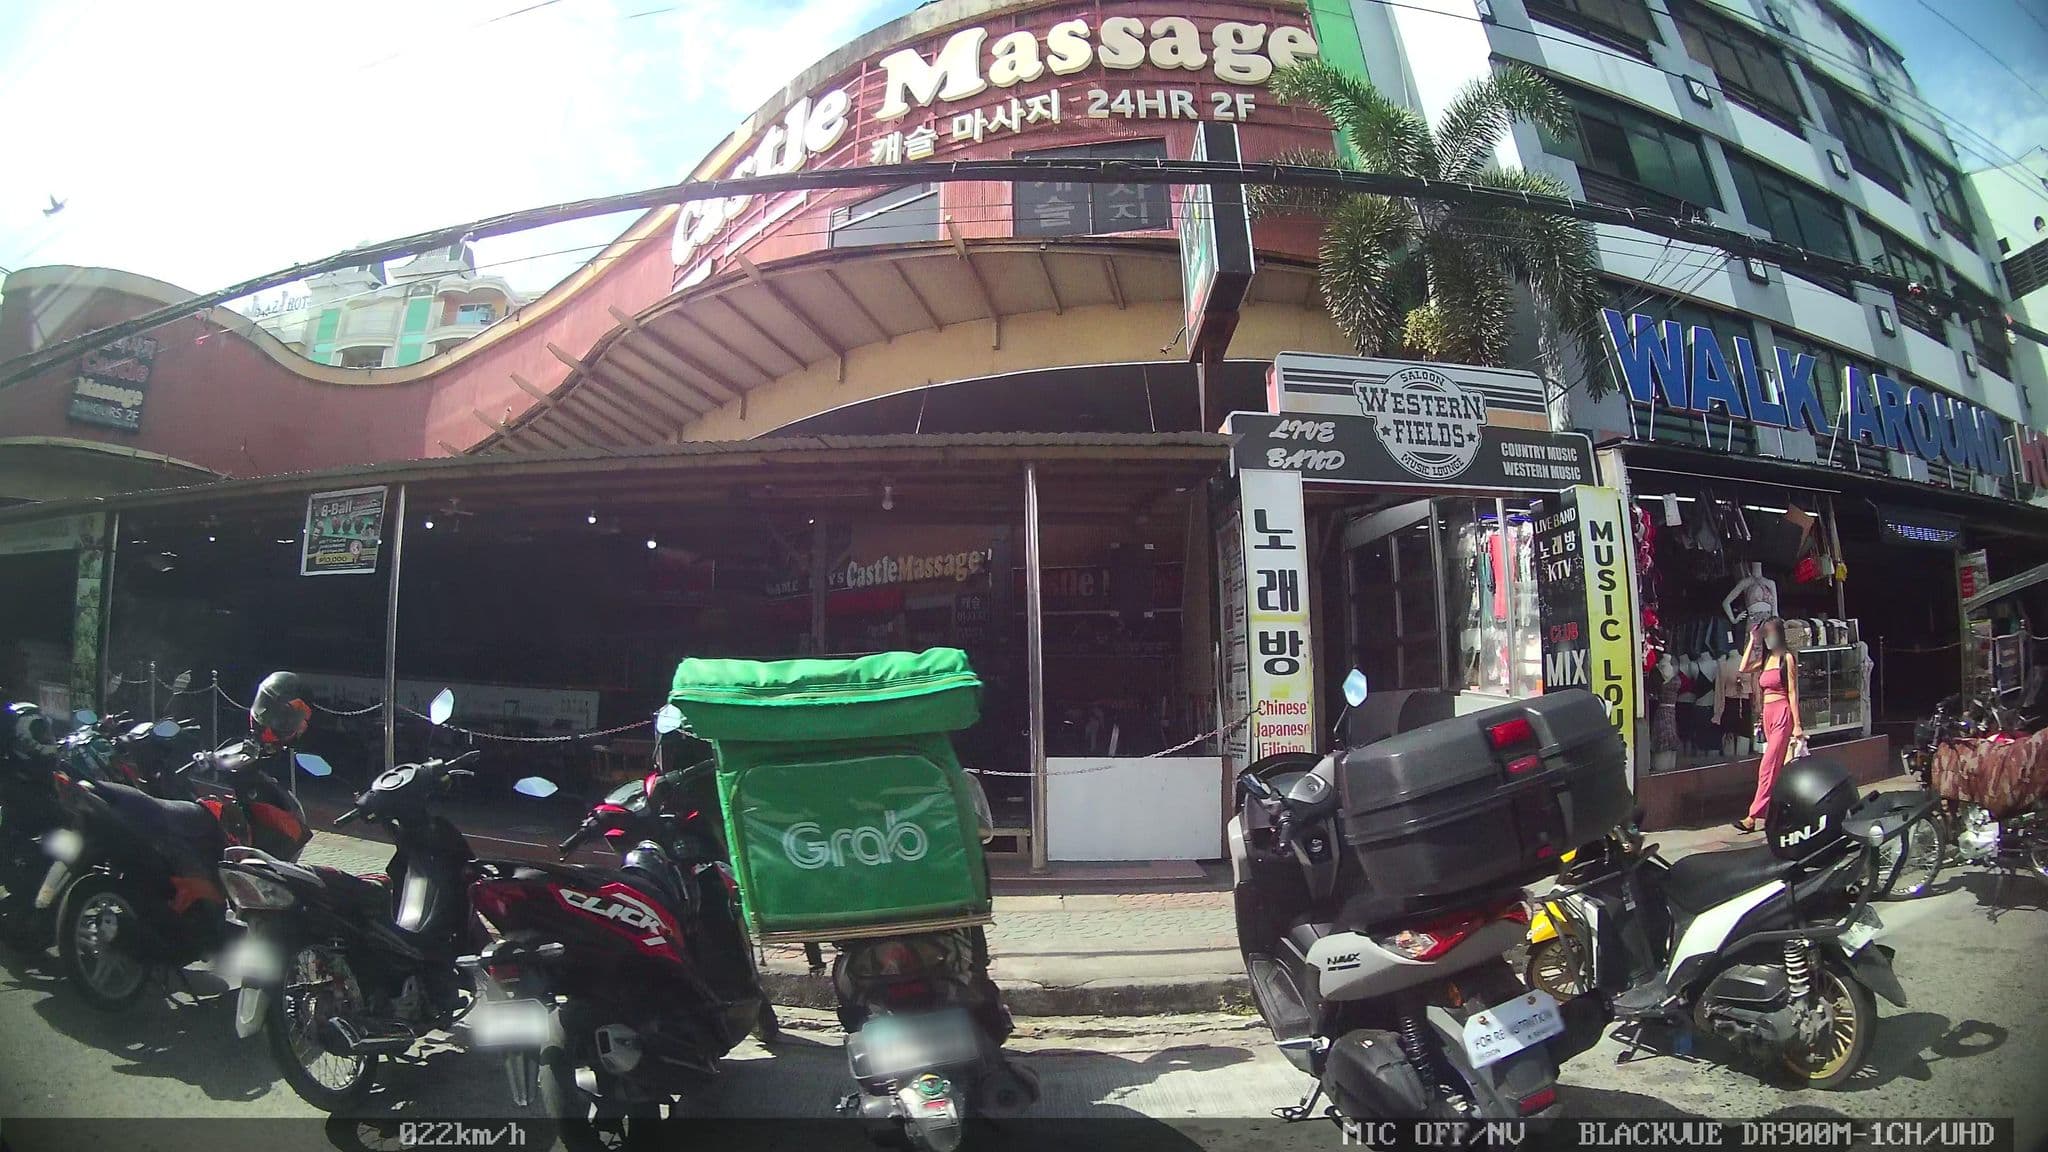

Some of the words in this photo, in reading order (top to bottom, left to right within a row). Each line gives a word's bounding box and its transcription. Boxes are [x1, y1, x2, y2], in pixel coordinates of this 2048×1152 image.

[874, 15, 1319, 122] Massage
[869, 124, 939, 165] 캐슬
[952, 88, 1061, 143] 마사지
[1087, 88, 1199, 119] 24HR
[1211, 91, 1257, 121] 2F
[1400, 371, 1446, 387] SALOON
[1601, 307, 1834, 436] WALK
[1843, 364, 2009, 478] AROUND
[1359, 386, 1483, 420] WESTERN
[1269, 419, 1336, 443] LIVE
[1393, 419, 1465, 448] FIELDS
[1266, 447, 1346, 471] BAND
[1401, 453, 1430, 475] MUSIC
[1432, 457, 1465, 477] LOUNGE
[1500, 442, 1545, 459] COUNTRY
[1546, 446, 1577, 462] MUSIC
[1502, 461, 1550, 479] WESTERN
[1550, 465, 1581, 480] MUSIC
[1535, 517, 1552, 534] LIVE
[1553, 508, 1576, 529] BAND
[1539, 530, 1576, 560] 노래방
[1548, 558, 1573, 583] KTV
[1589, 520, 1622, 642] MUSIC
[1254, 508, 1304, 676] 노래방
[1546, 649, 1588, 687] MIX
[1258, 699, 1307, 716] Chinese
[1603, 659, 1627, 747] LOU
[1254, 722, 1310, 738] Japanese
[782, 810, 930, 870] Grab
[1780, 814, 1827, 848] HNJ
[560, 888, 661, 936] CLICK
